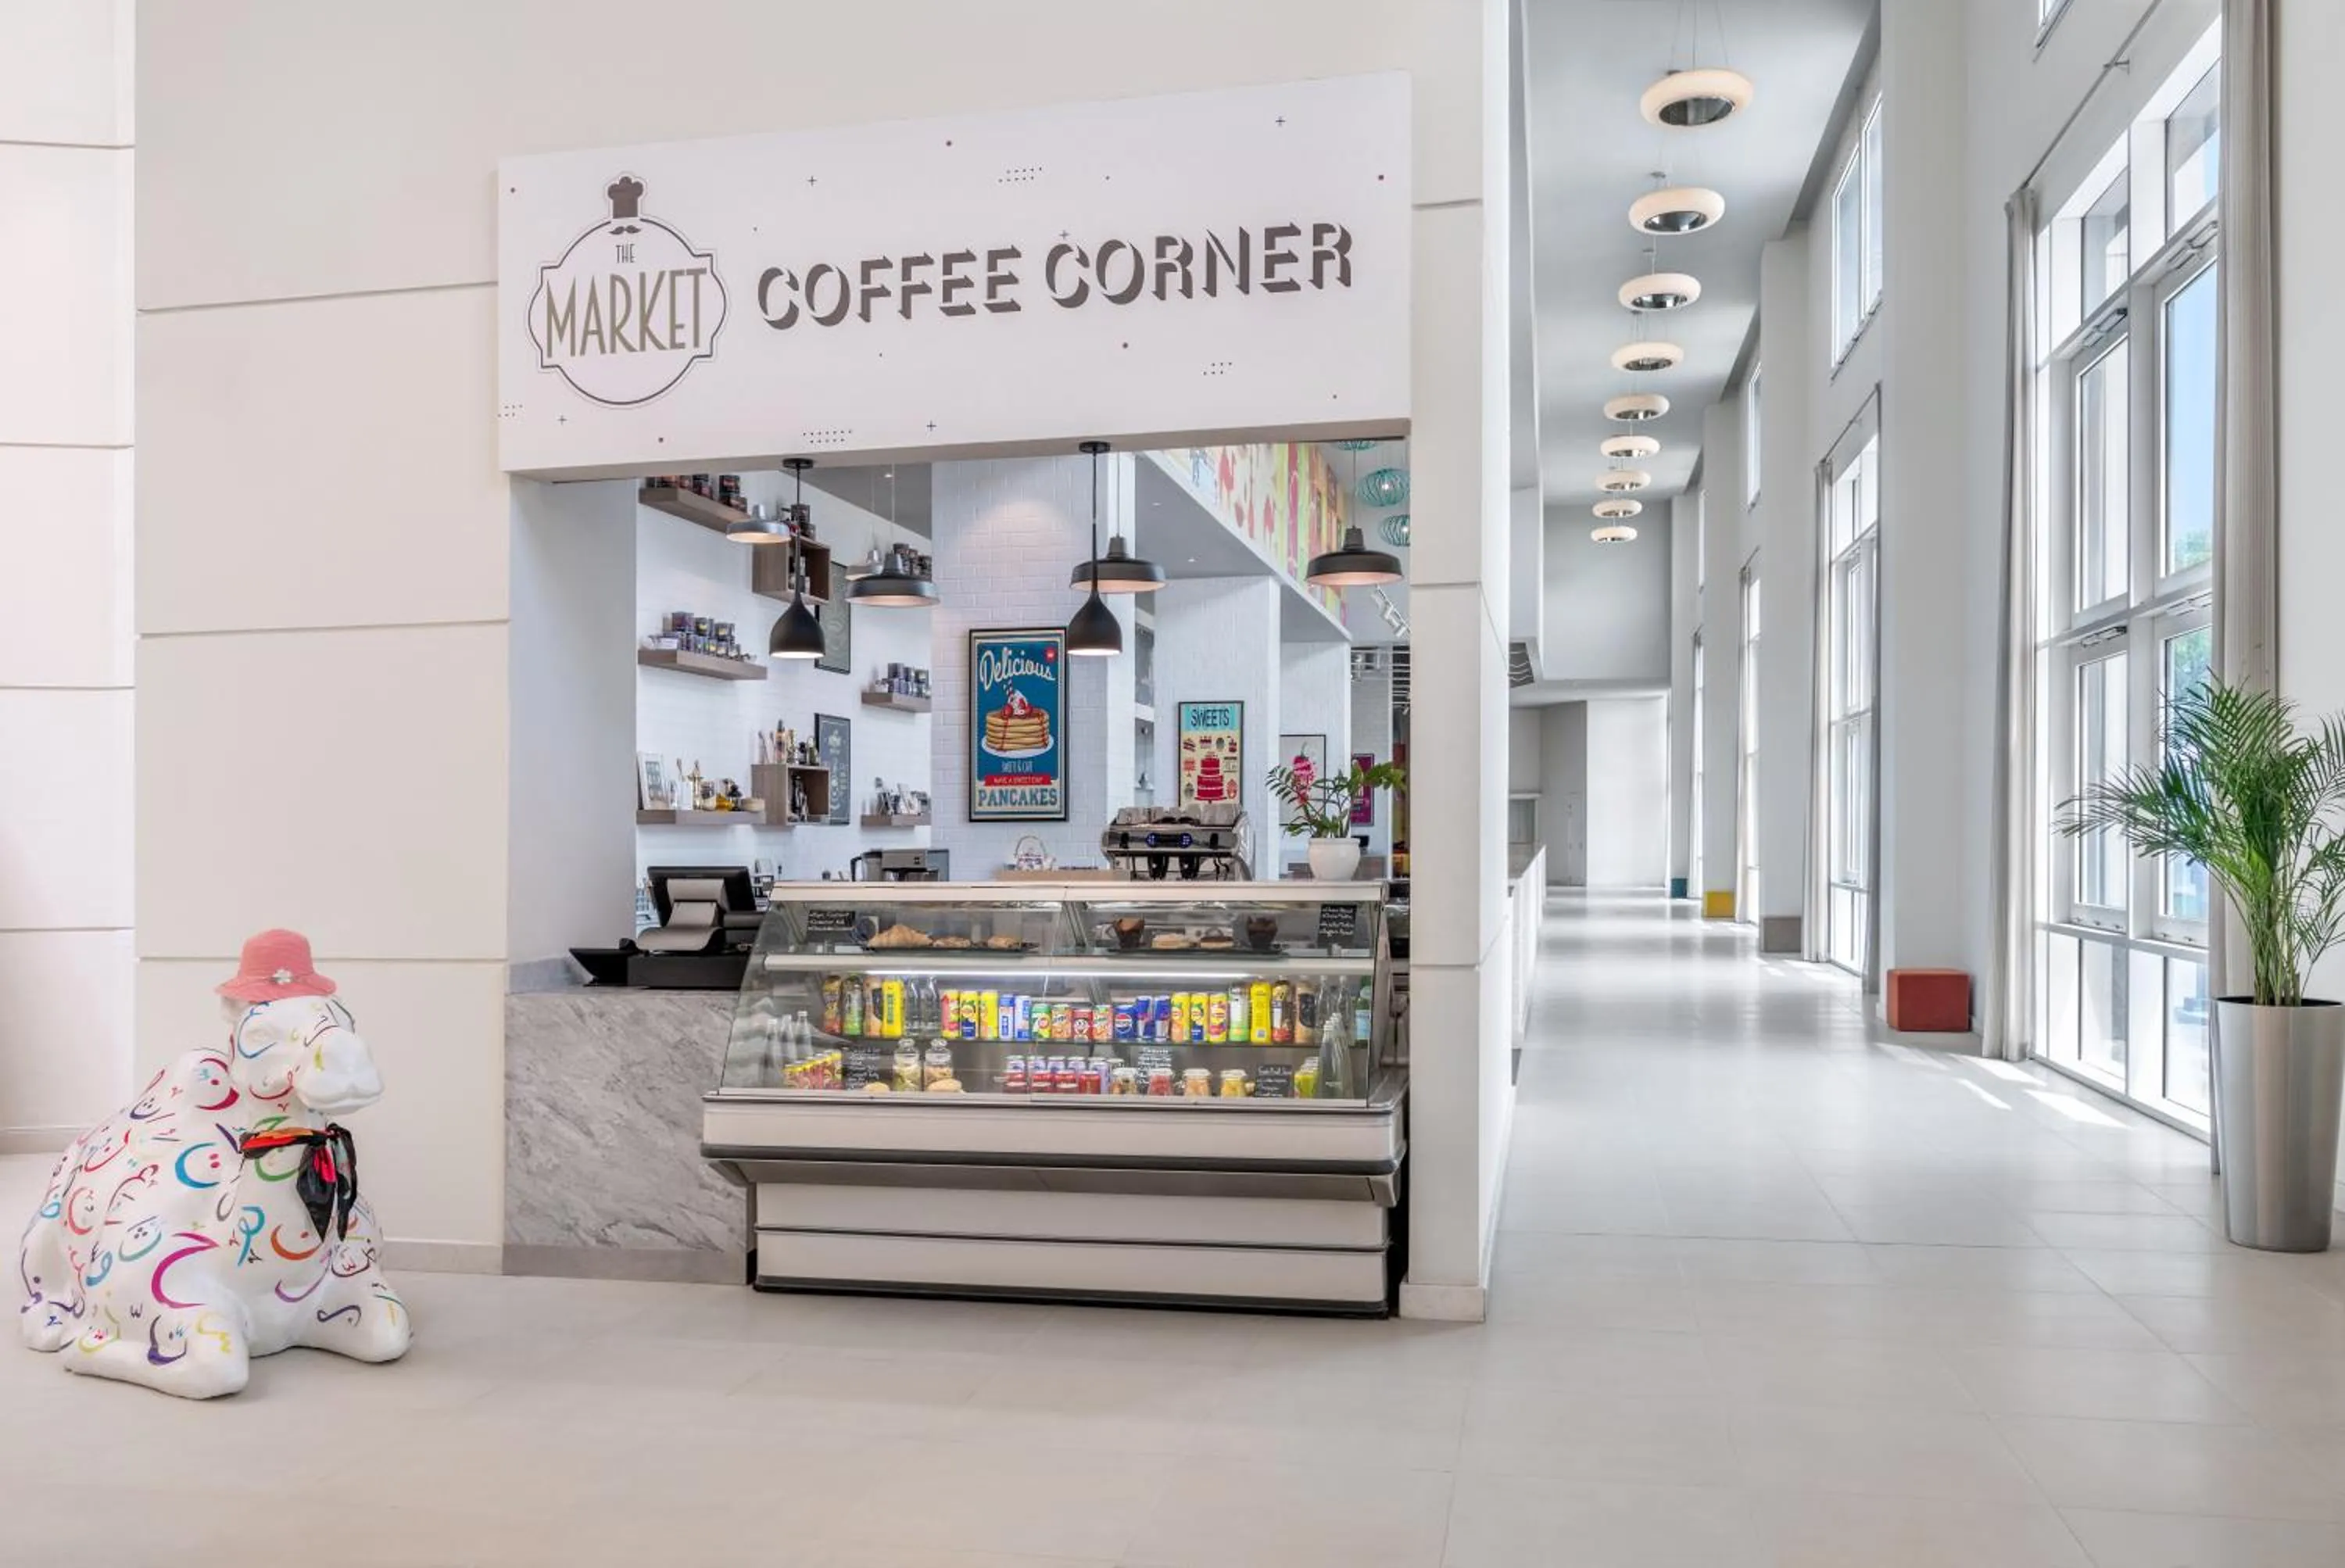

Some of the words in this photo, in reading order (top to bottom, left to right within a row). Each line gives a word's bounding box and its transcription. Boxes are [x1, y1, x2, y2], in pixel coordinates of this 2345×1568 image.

[615, 243, 635, 263] THE
[757, 245, 1022, 330] COFFEE
[1045, 222, 1352, 308] CORNER
[546, 267, 707, 358] MARKET
[980, 646, 1055, 690] Delicious
[1190, 708, 1230, 727] SWEETS
[979, 788, 1058, 807] PANCAKES
